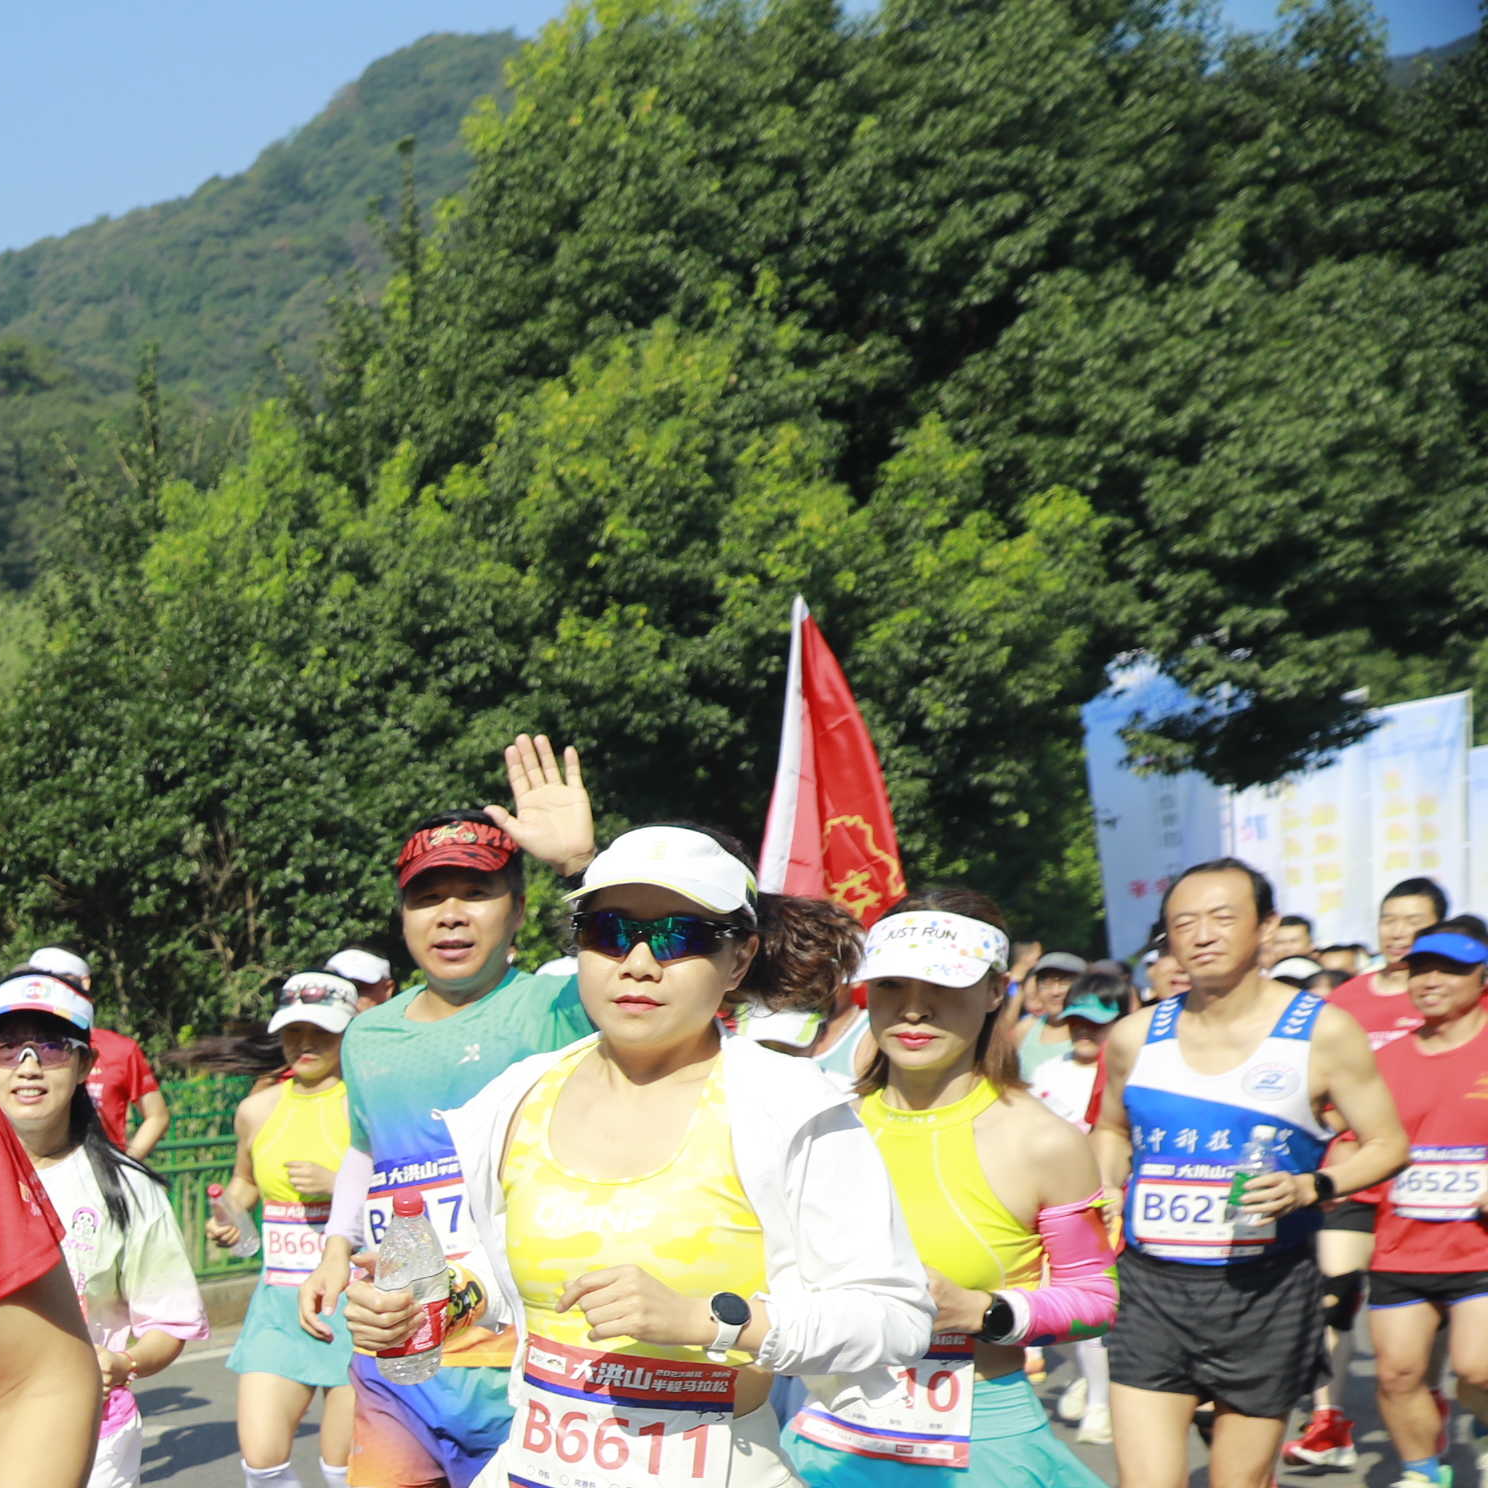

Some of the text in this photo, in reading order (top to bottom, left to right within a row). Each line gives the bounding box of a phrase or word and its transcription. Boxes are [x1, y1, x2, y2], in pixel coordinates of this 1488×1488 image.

[884, 926, 958, 941] JUST RUN
[570, 1359, 653, 1390] 大洪山
[523, 1399, 709, 1479] B6611
